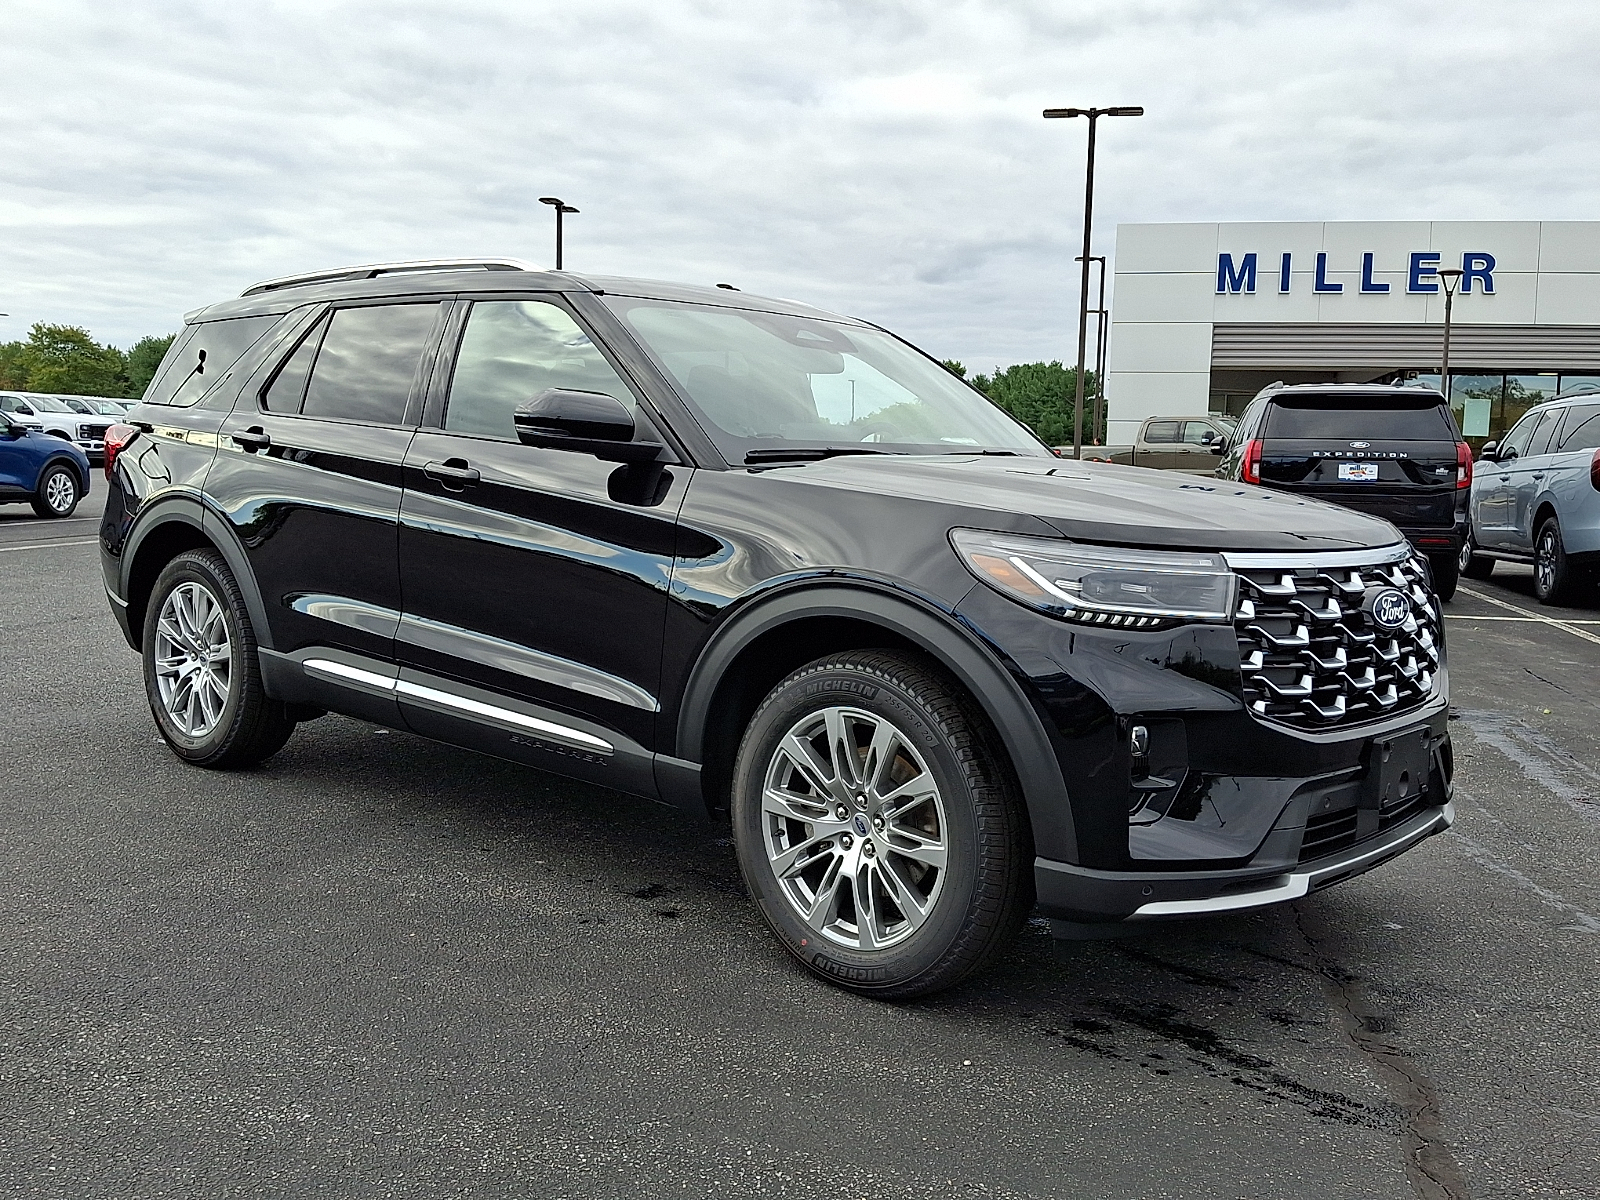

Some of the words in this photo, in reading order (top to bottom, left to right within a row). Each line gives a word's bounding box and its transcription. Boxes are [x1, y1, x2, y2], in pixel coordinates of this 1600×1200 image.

[1215, 251, 1497, 294] MILLER
[1380, 596, 1405, 622] Ford
[806, 680, 876, 697] MICHELIN
[509, 735, 607, 766] EXPLORER
[814, 956, 886, 982] MICHELIN
